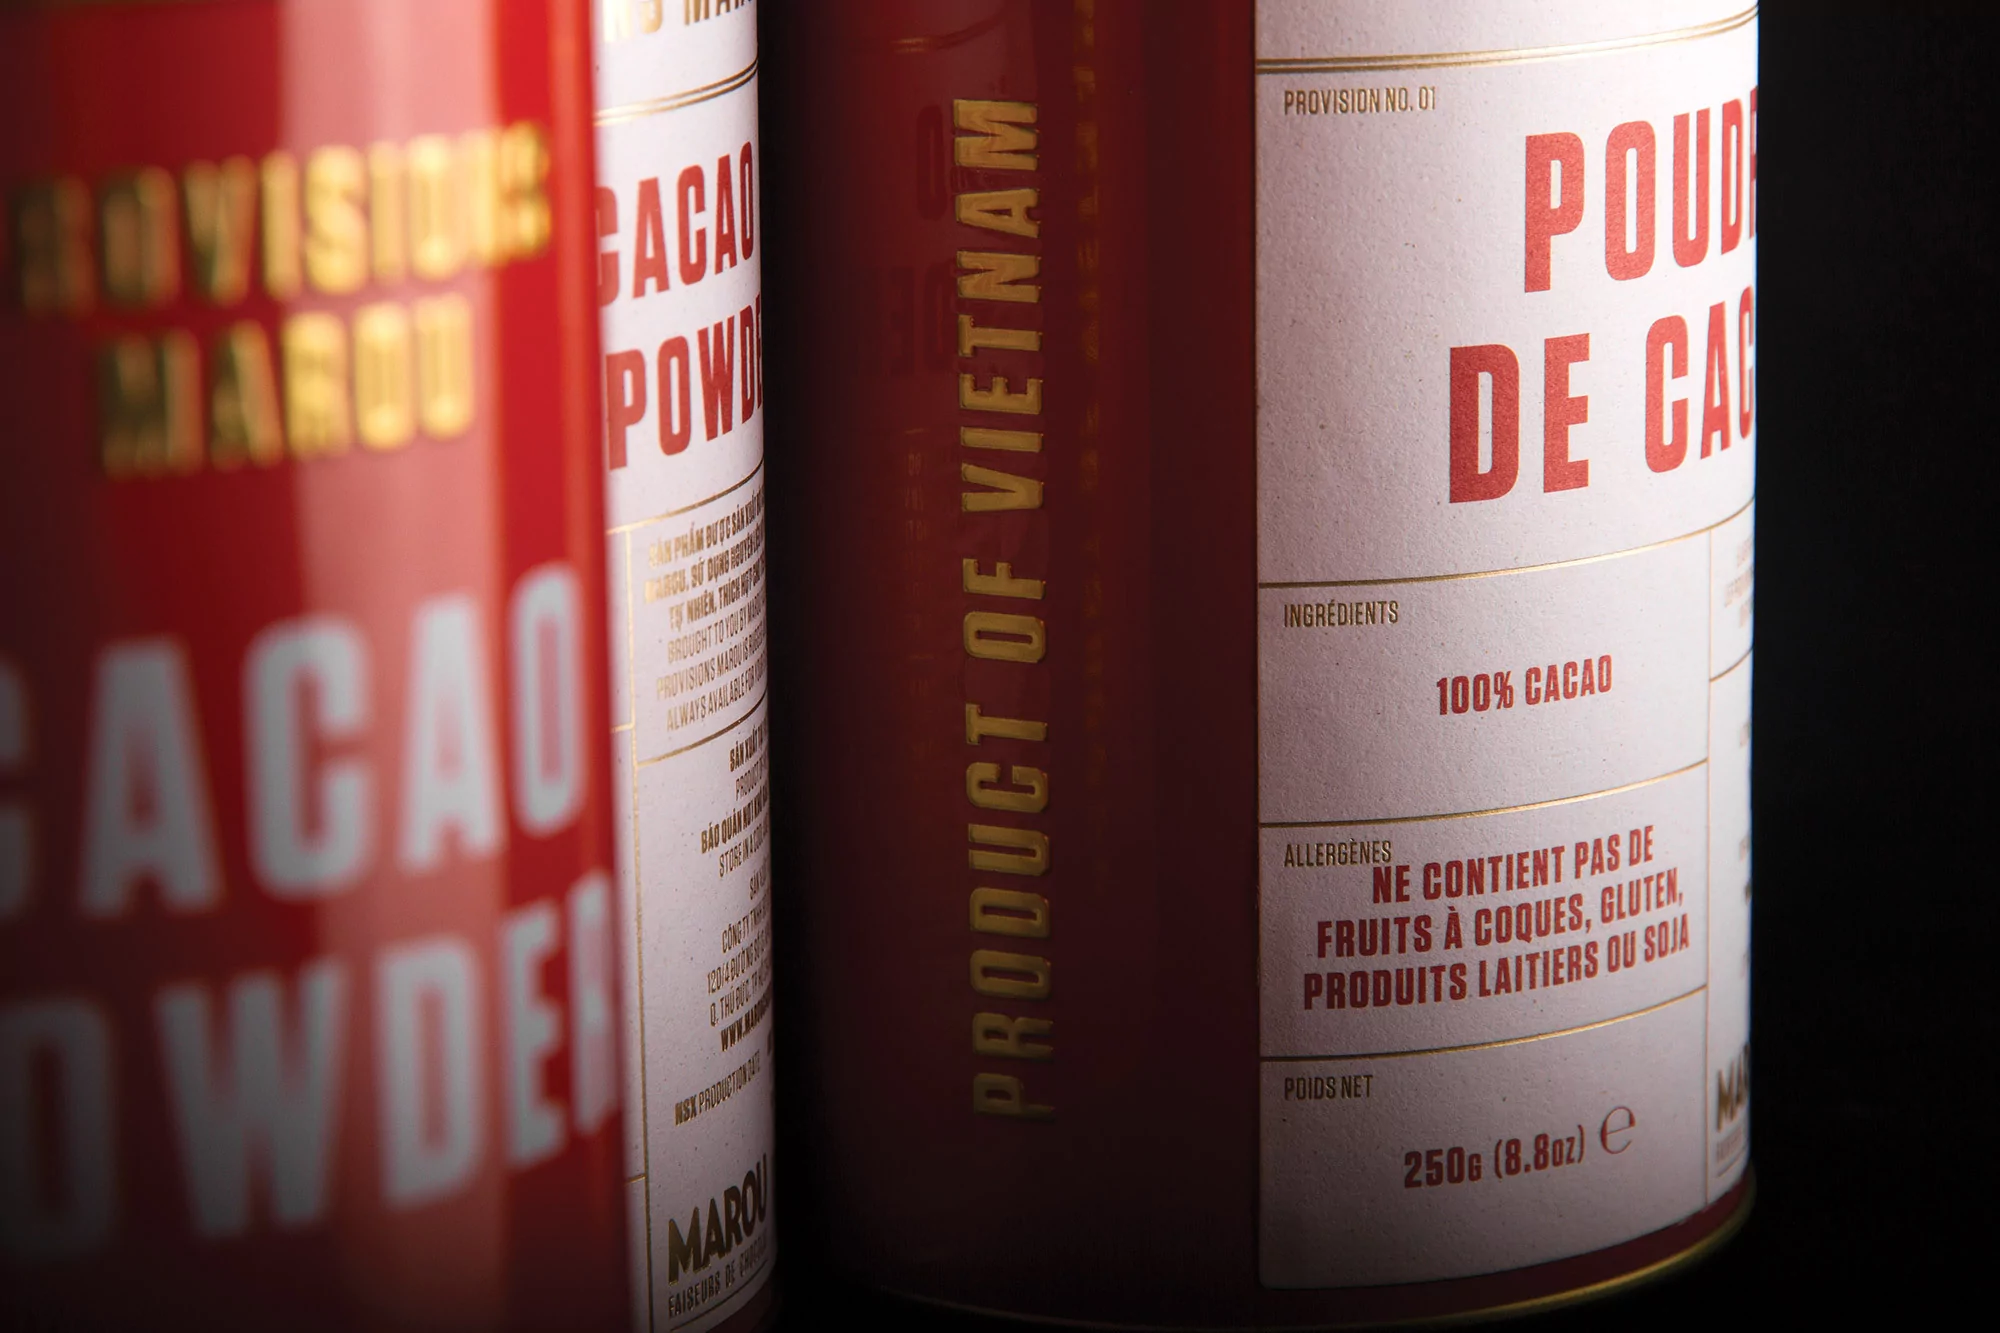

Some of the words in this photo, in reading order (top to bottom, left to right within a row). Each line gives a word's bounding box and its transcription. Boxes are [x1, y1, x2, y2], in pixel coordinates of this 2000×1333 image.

[1284, 87, 1380, 116] PROVISION
[1385, 87, 1414, 113] NO.
[1418, 86, 1437, 111] 01
[953, 98, 1045, 513] VIETNAM
[1449, 333, 1590, 504] DE
[963, 557, 1048, 664] OF
[1284, 599, 1399, 628] INGRÉDIENTS
[667, 625, 712, 665] BROUGHT
[714, 619, 725, 646] TO
[657, 657, 716, 701] PROVISIONS
[1436, 670, 1514, 716] 100%
[1525, 655, 1613, 706] CACAO
[0, 562, 583, 915] ACAO
[667, 695, 707, 732] ALWAYS
[1284, 838, 1392, 869] ALLERGÈNES
[1372, 864, 1411, 905] NE
[1423, 845, 1565, 903] CONTIENT
[1575, 833, 1621, 880] PAS
[1628, 825, 1655, 867] DE
[965, 702, 1056, 1122] PRODUCT
[1316, 913, 1432, 960] FRUITS
[1444, 905, 1463, 951] À
[1474, 892, 1591, 946] COQUES,
[1600, 866, 1684, 924] GLUTEN,
[1303, 962, 1467, 1011] PRODUITS
[1478, 939, 1598, 998] LAITIERS
[1607, 931, 1637, 974] OU
[1644, 912, 1690, 965] SOJA
[698, 1063, 748, 1115] PRODUCTION
[1284, 1075, 1337, 1102] POIDS
[1341, 1074, 1374, 1099] NET
[668, 1152, 767, 1286] MAROU
[668, 1270, 721, 1318] FAISEURS
